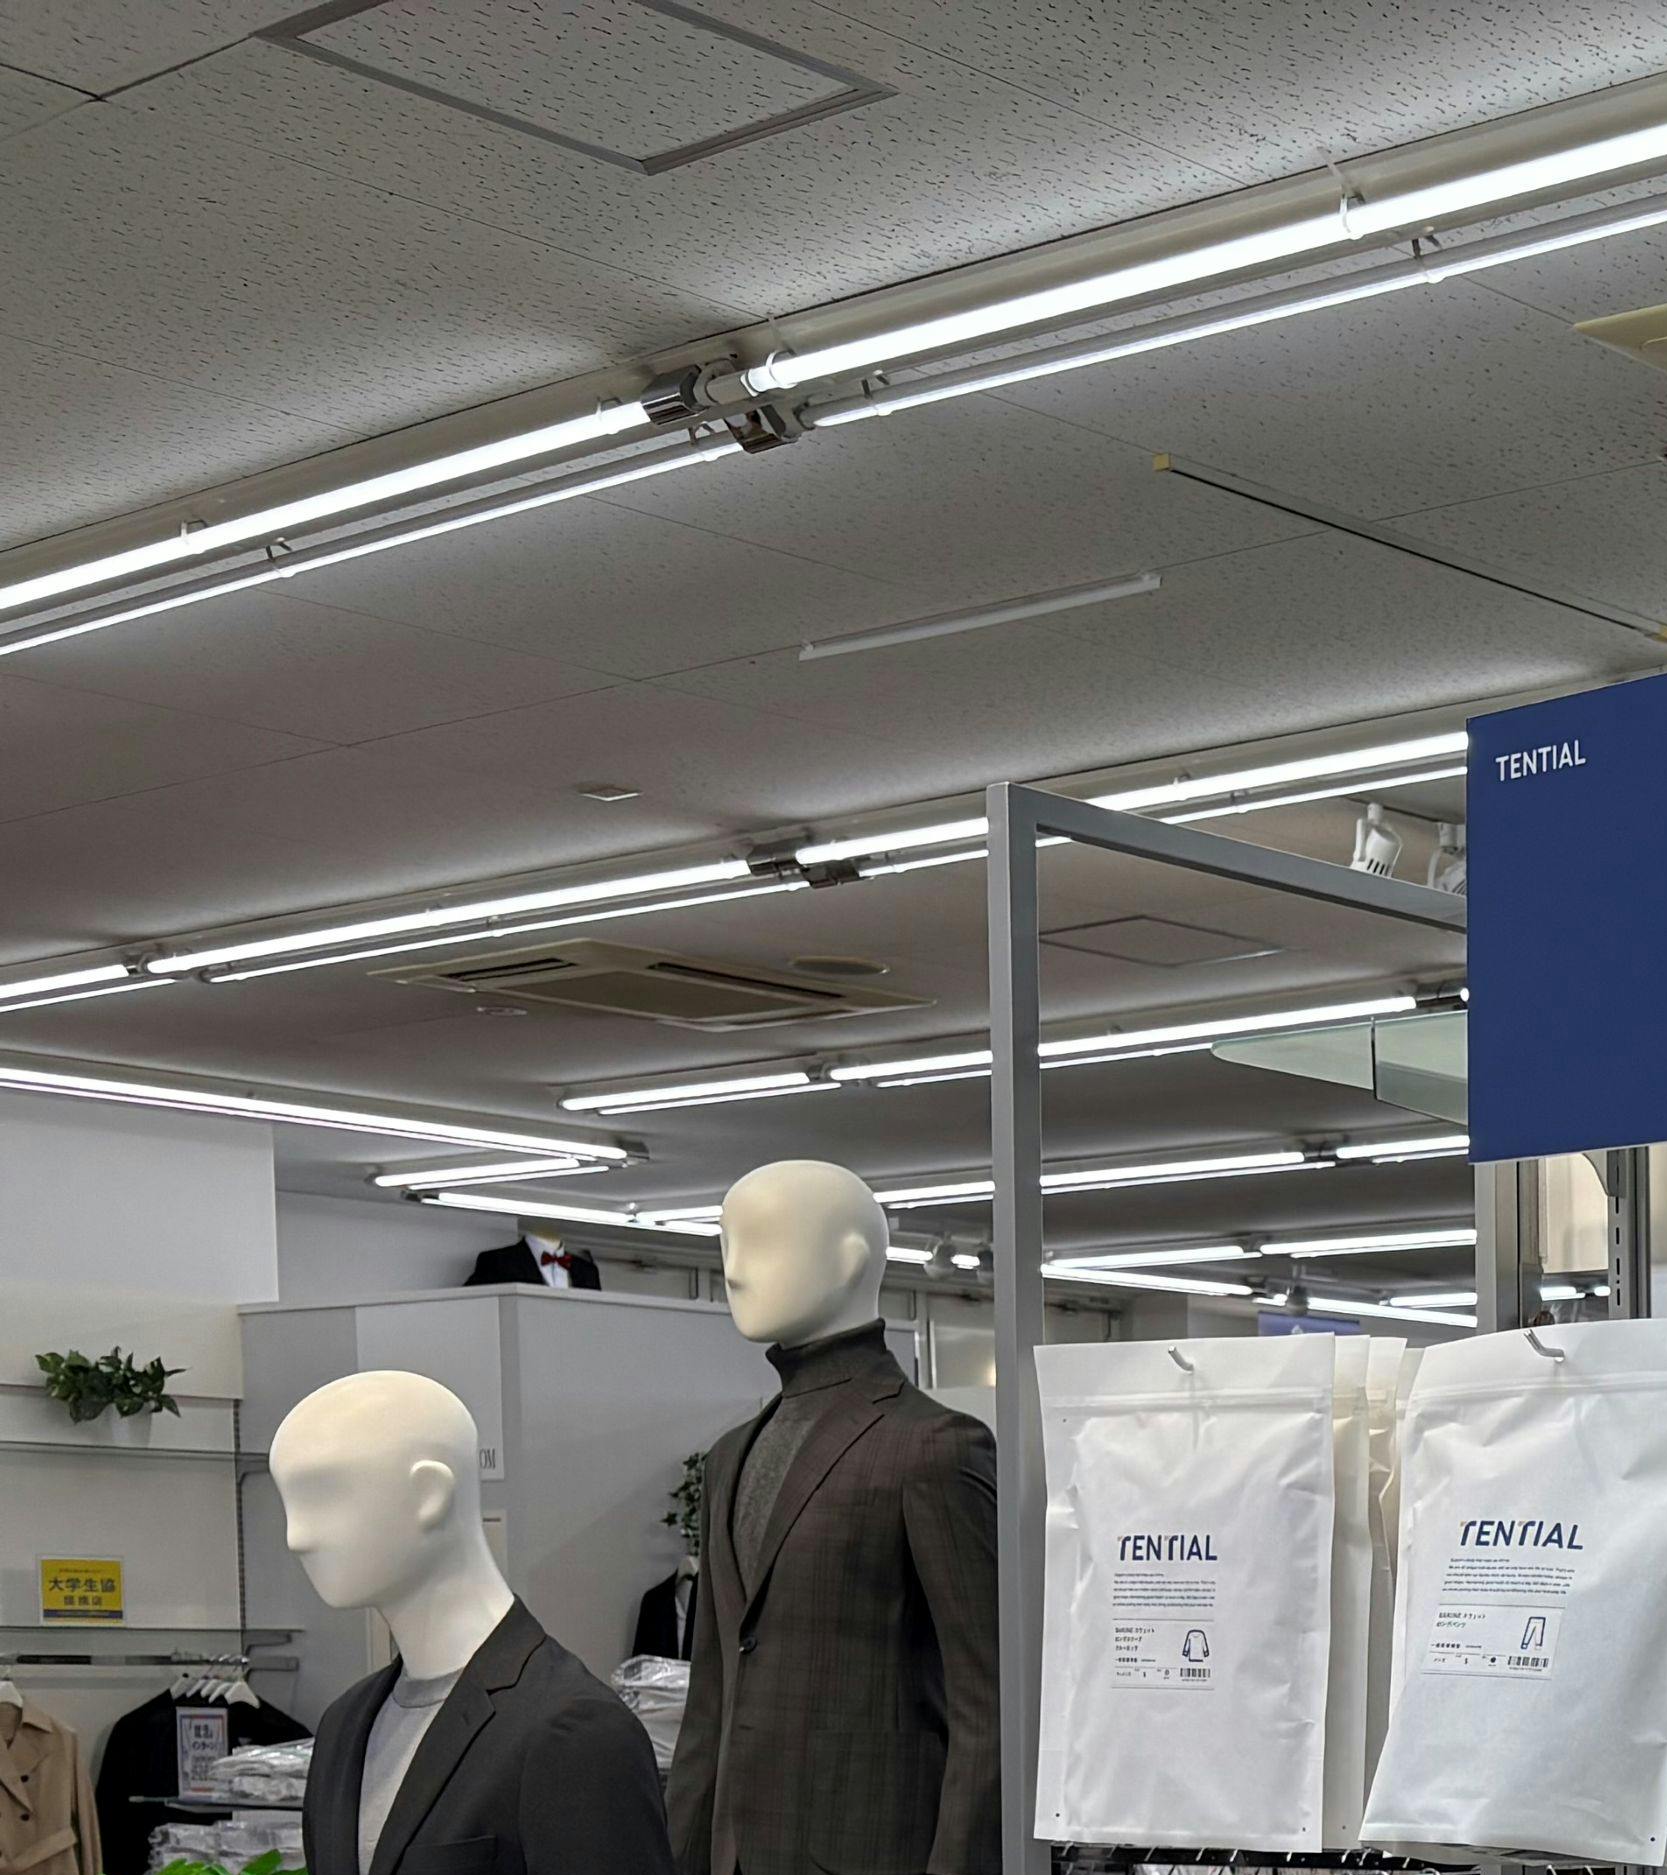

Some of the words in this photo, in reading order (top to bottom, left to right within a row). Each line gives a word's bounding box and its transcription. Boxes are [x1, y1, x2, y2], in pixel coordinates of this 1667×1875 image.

[1496, 738, 1587, 782] TENTIAL
[1118, 1535, 1218, 1561] TENTIAL
[1460, 1520, 1583, 1550] TENTIAL
